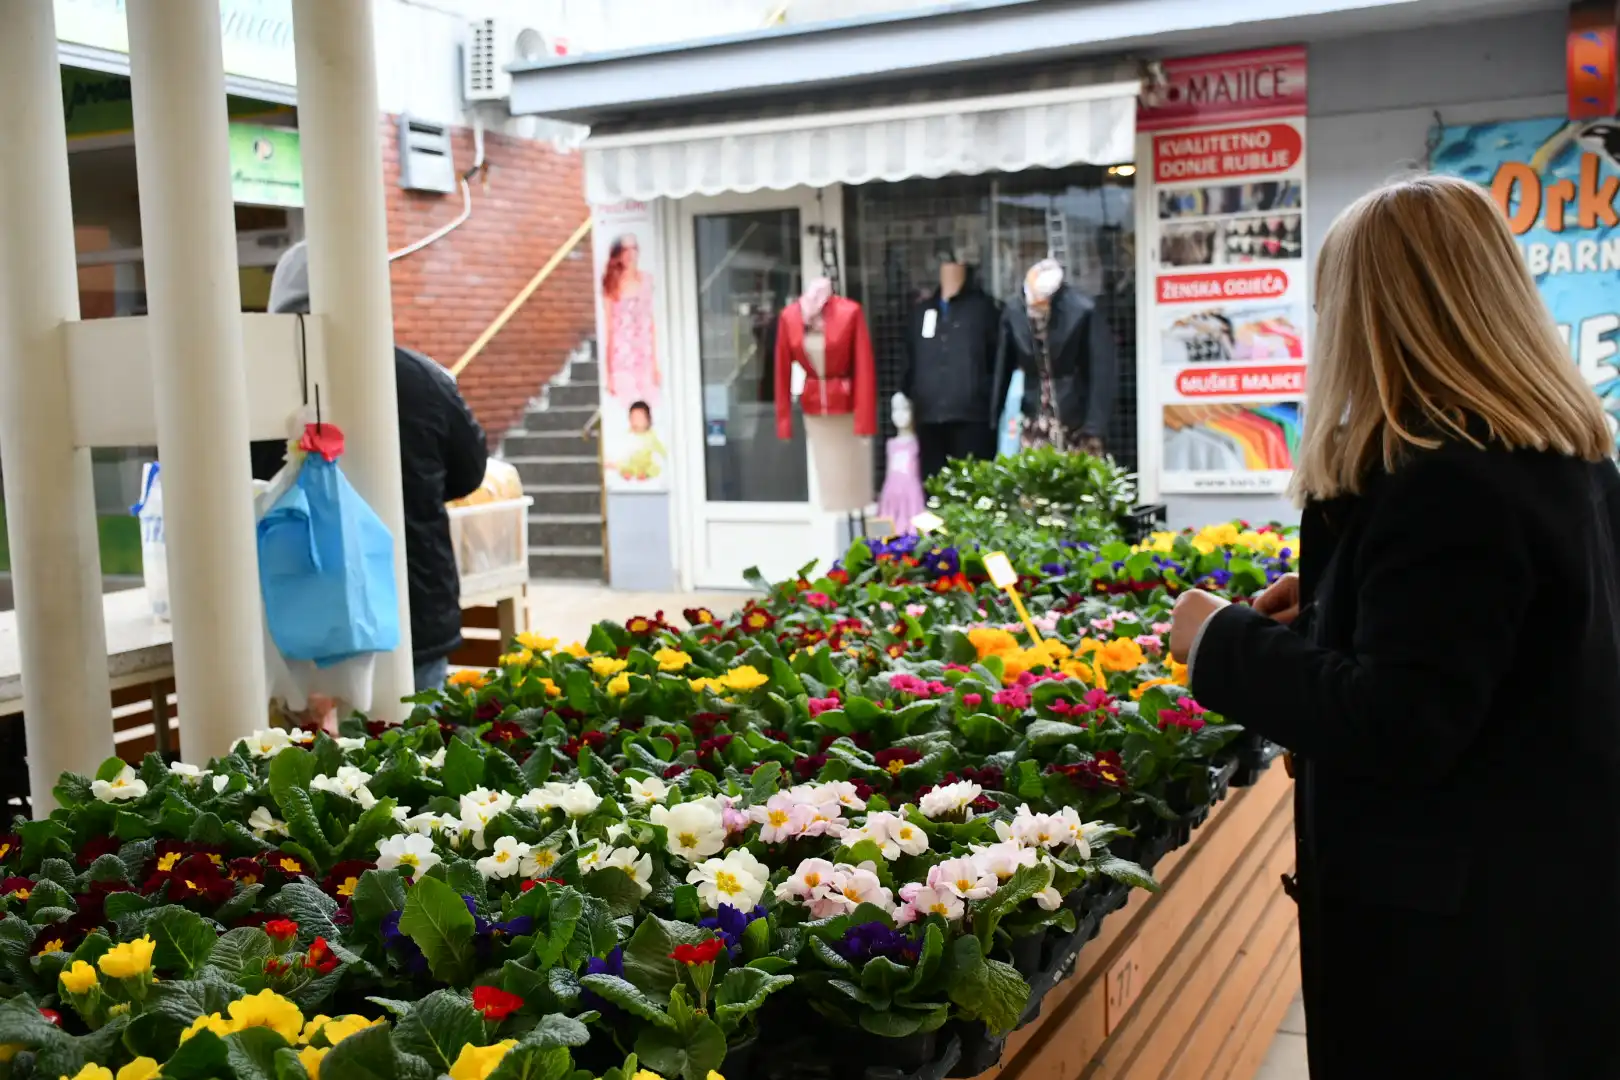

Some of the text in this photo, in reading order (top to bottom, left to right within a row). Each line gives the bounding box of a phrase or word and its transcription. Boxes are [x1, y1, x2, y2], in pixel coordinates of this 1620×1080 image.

[1159, 130, 1271, 156] KVALITETNO
[1159, 150, 1290, 178] DONJE RUBLJE
[1162, 273, 1284, 300] ŽENSKA ODJEĆA
[1180, 372, 1238, 392] MUŠKE
